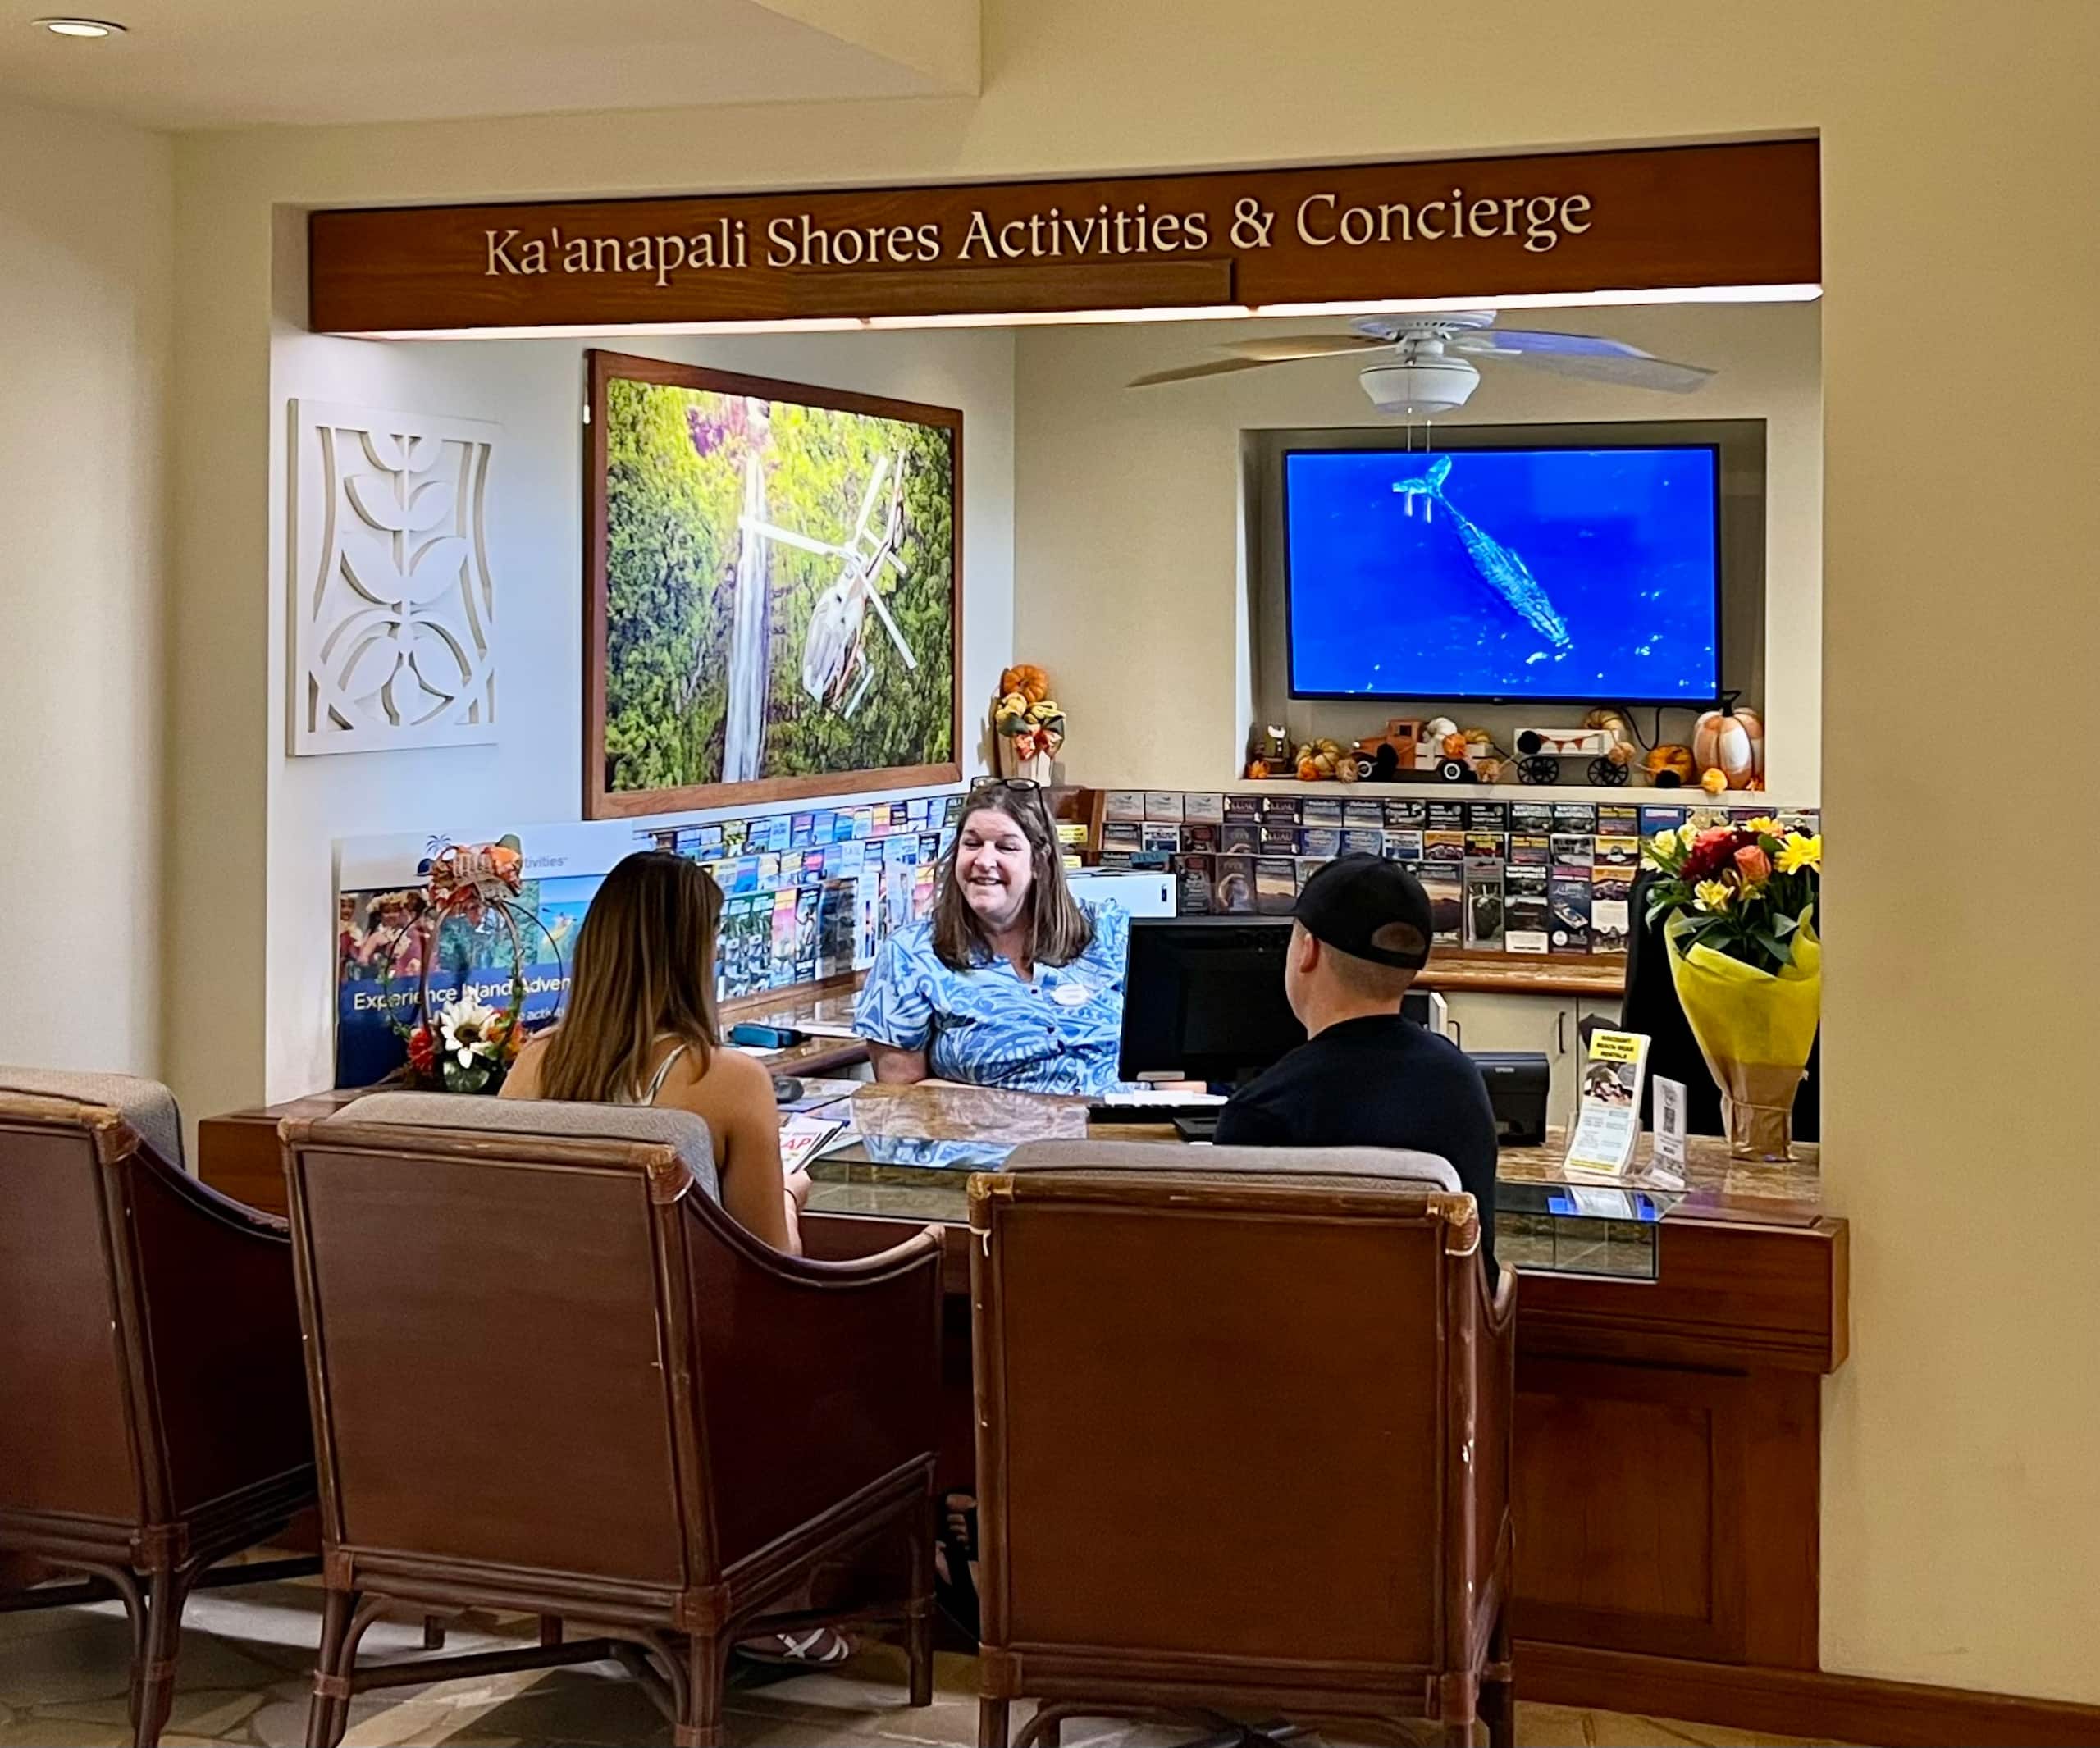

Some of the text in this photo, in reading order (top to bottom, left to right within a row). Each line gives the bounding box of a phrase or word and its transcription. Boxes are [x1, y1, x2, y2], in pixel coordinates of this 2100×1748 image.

[485, 189, 1591, 287] Ka'anapali Shores Activities & Concierge
[524, 856, 565, 869] tivities
[462, 979, 514, 1005] Iland
[520, 974, 572, 994] Adven
[781, 1137, 813, 1151] AP
